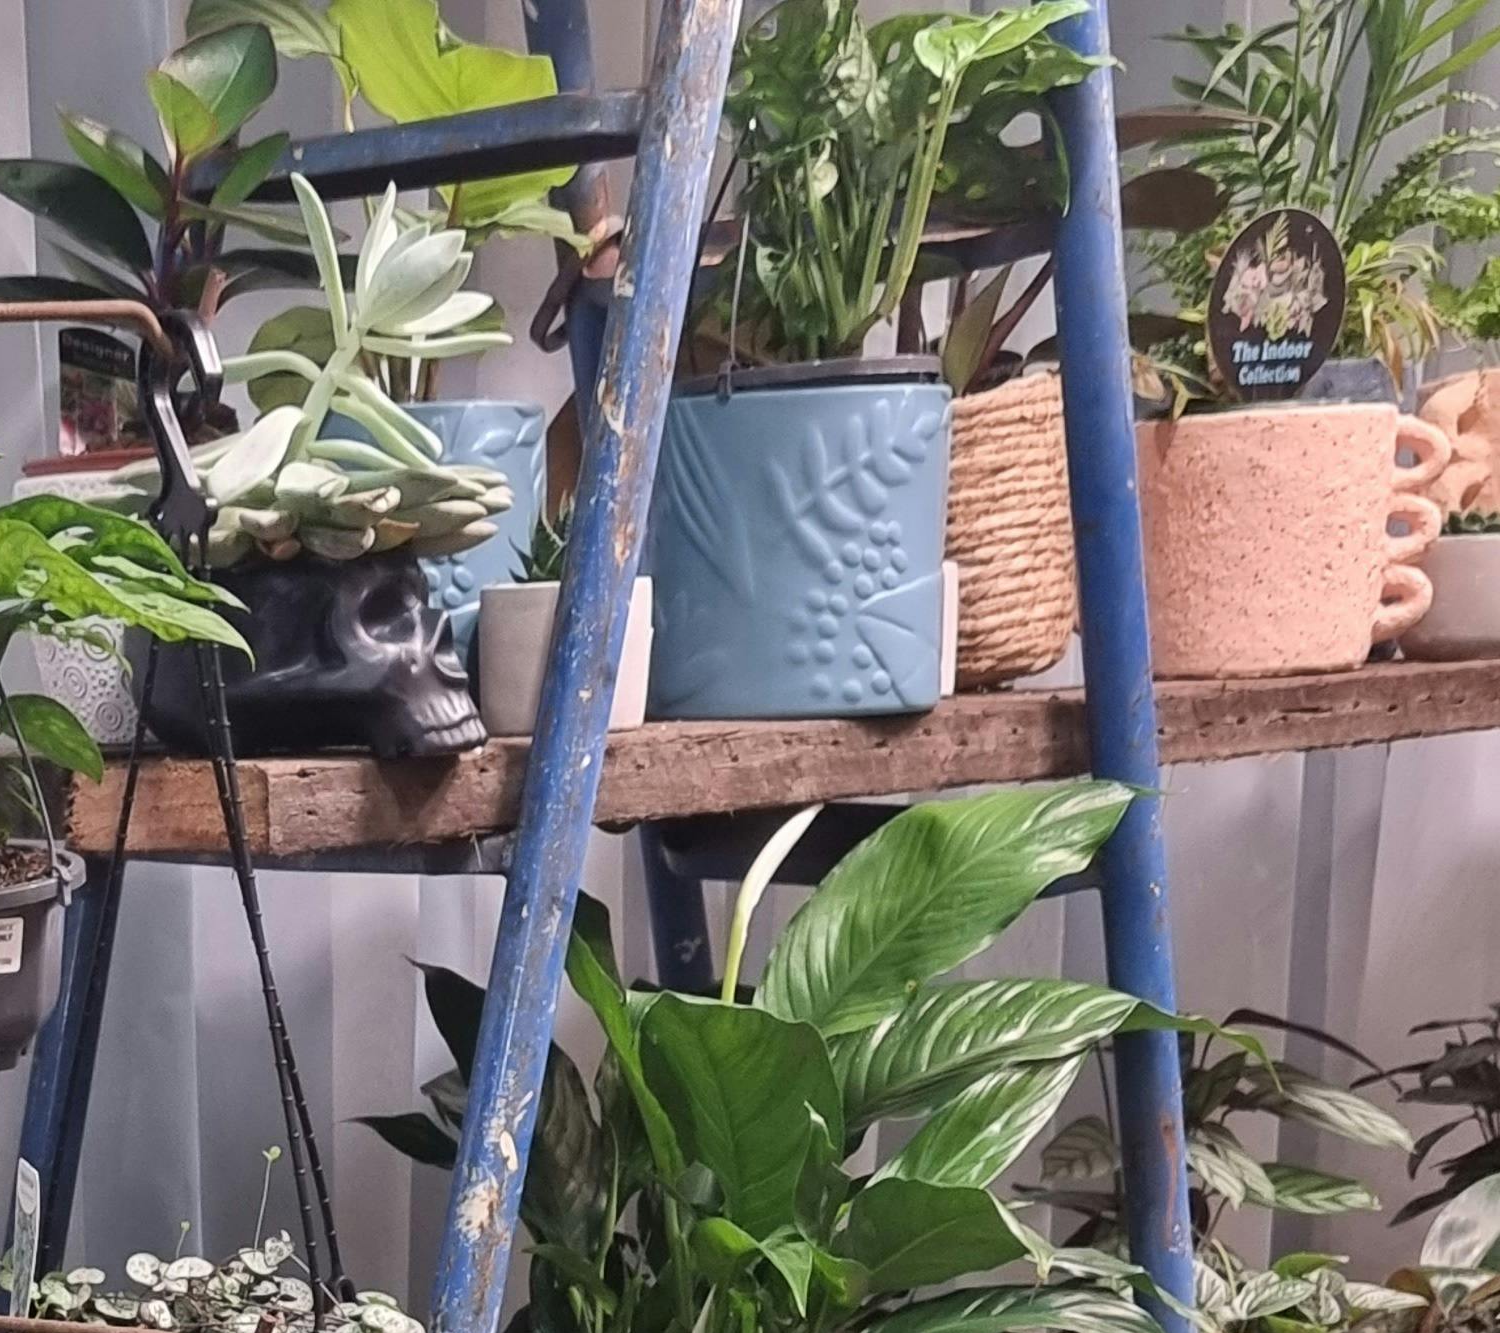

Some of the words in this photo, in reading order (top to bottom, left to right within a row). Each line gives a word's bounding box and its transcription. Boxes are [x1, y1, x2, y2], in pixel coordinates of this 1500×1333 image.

[62, 333, 132, 363] Designer
[1232, 341, 1260, 363] The
[1261, 339, 1314, 361] Indoor
[1238, 365, 1301, 386] Collection
